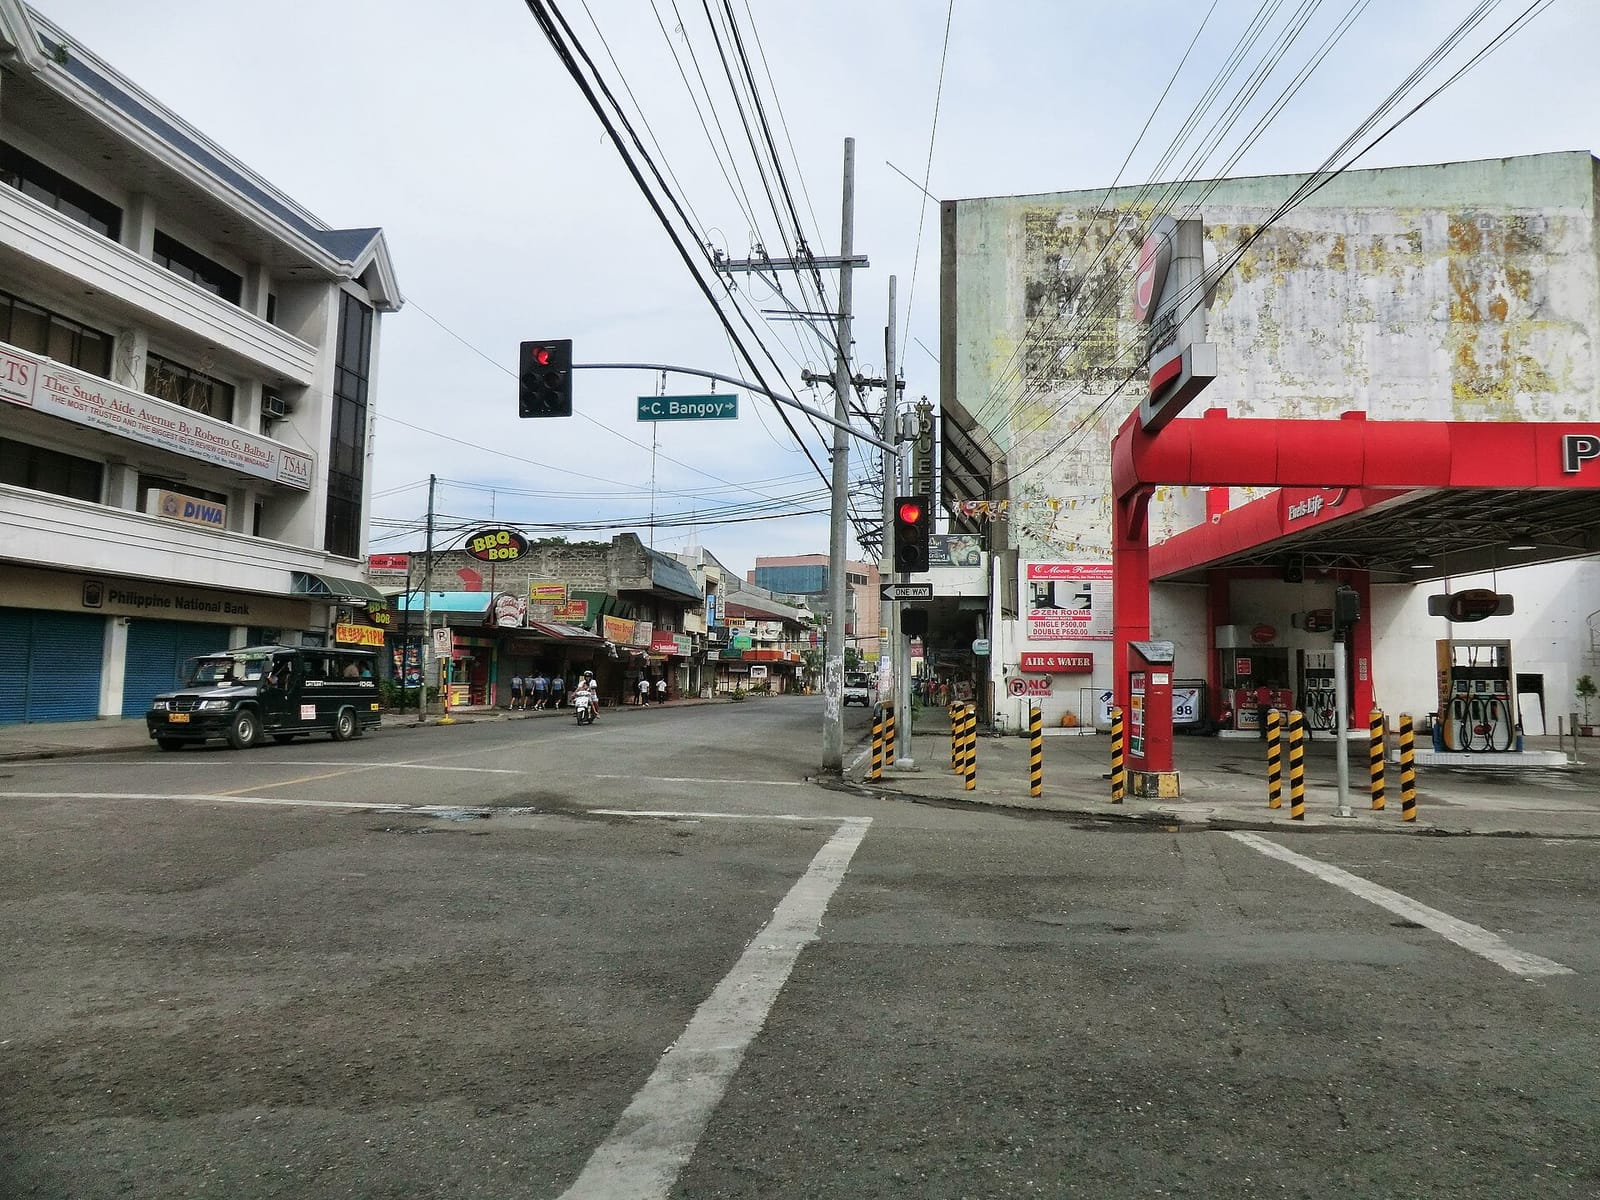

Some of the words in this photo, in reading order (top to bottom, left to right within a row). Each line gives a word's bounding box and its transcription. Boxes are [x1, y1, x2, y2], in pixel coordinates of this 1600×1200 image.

[0, 357, 28, 386] TS
[43, 374, 69, 394] The
[73, 385, 107, 407] Study
[110, 398, 135, 416] Aide
[138, 408, 176, 430] Avenue
[178, 421, 192, 435] By
[194, 426, 230, 447] Roberto
[232, 439, 242, 451] G.
[651, 402, 665, 415] C.
[669, 402, 724, 416] Bangoy
[51, 394, 65, 405] THE
[68, 400, 88, 412] MOST
[90, 406, 121, 423] TRUSTED
[122, 418, 136, 428] AND
[138, 422, 150, 433] THE
[152, 426, 178, 442] BIGGEST
[179, 436, 194, 446] IELTS
[195, 440, 217, 454] REVIEW
[217, 446, 238, 460] CENTER
[244, 455, 269, 469] MINDANAO
[284, 455, 307, 476] TSAA
[184, 502, 222, 524] DIWA
[473, 531, 510, 552] BBQ
[488, 547, 518, 560] BOB
[108, 589, 171, 608] Philippine
[175, 596, 221, 613] National
[224, 602, 250, 616] Bank
[375, 612, 391, 624] BOB
[1309, 617, 1316, 628] 2
[1026, 658, 1044, 666] AIR
[1057, 658, 1090, 666] WATER
[1028, 680, 1050, 689] NO
[1176, 706, 1192, 716] 98
